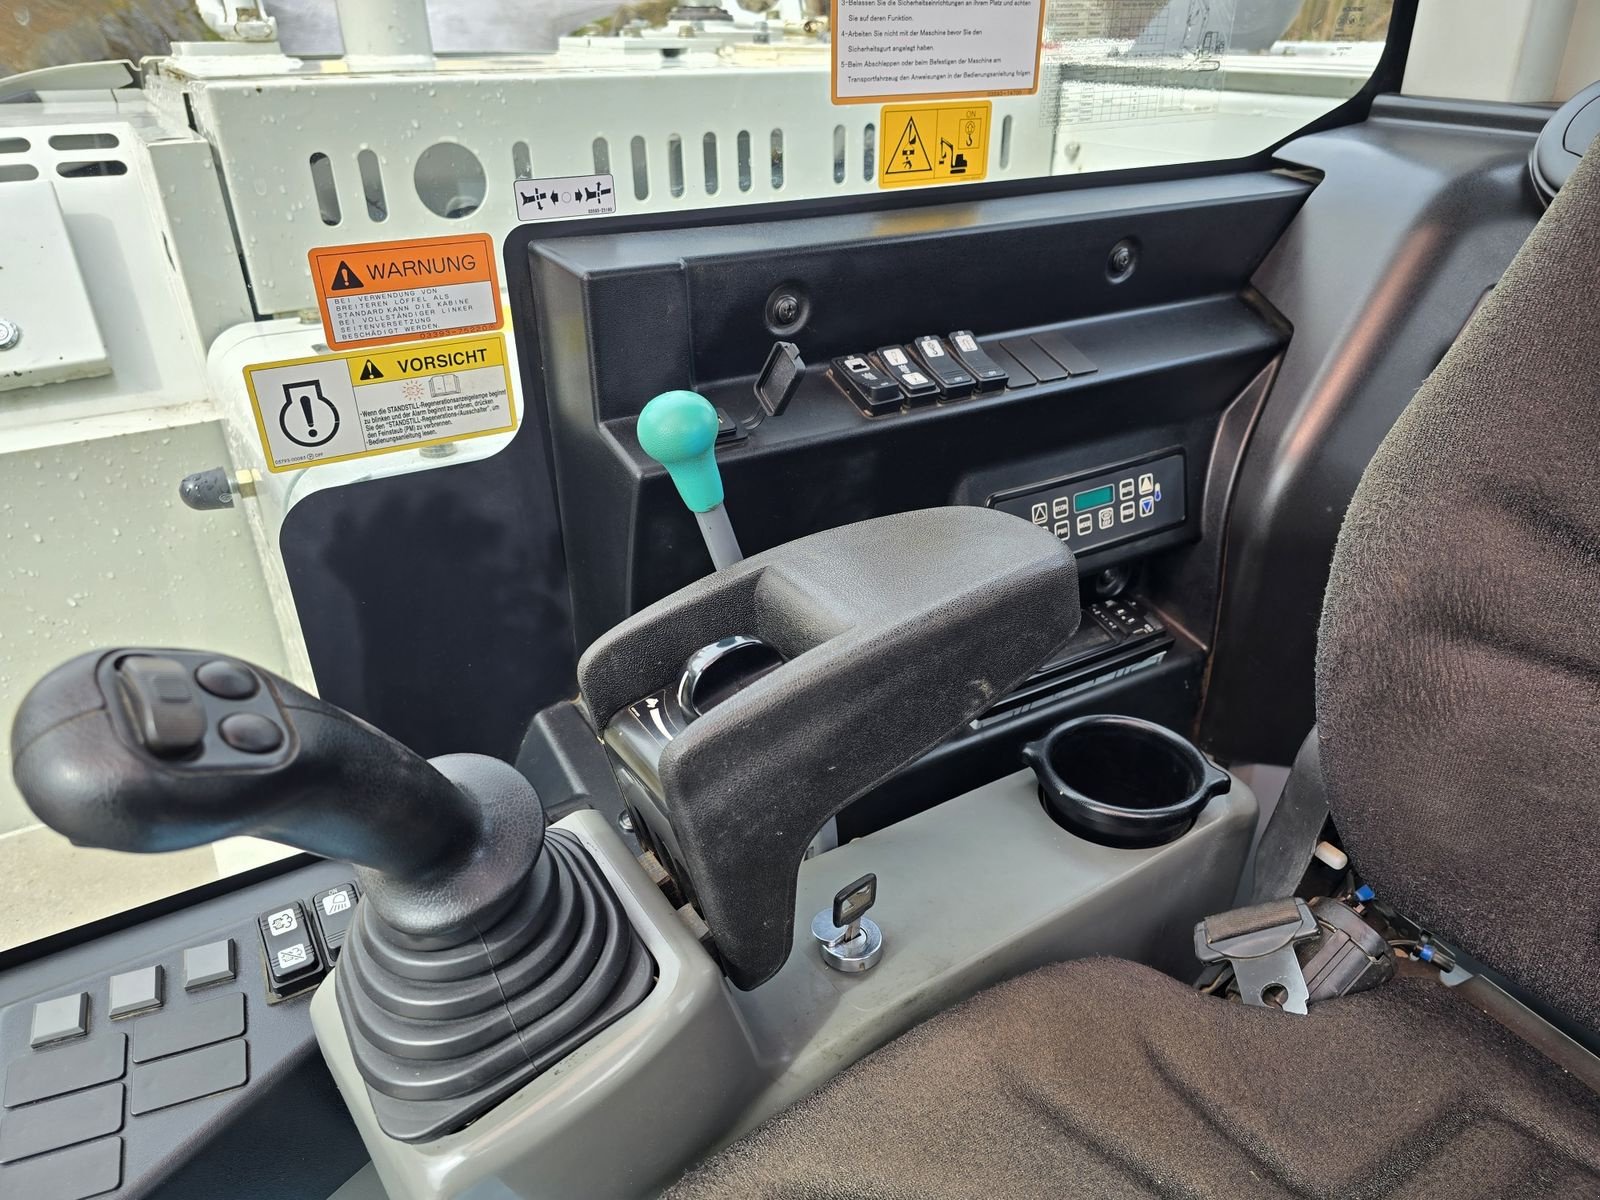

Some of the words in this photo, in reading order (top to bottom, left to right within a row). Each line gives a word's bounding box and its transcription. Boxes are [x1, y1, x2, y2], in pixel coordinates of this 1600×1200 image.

[366, 254, 476, 280] WARNUNG
[336, 301, 388, 312] BREITEREN
[394, 296, 427, 305] LÖFFEL
[358, 291, 415, 302] VERWENDUNG
[337, 309, 384, 319] STANDARD
[437, 298, 470, 307] KABINE
[362, 309, 435, 323] VOLLSTÄNDIGER
[442, 305, 473, 314] LINKER
[341, 317, 431, 333] SEITENVERSETZUNG
[342, 328, 398, 340] BESCHÄDIGT
[397, 348, 487, 373] VORSICHT
[378, 428, 403, 436] Feinstaub
